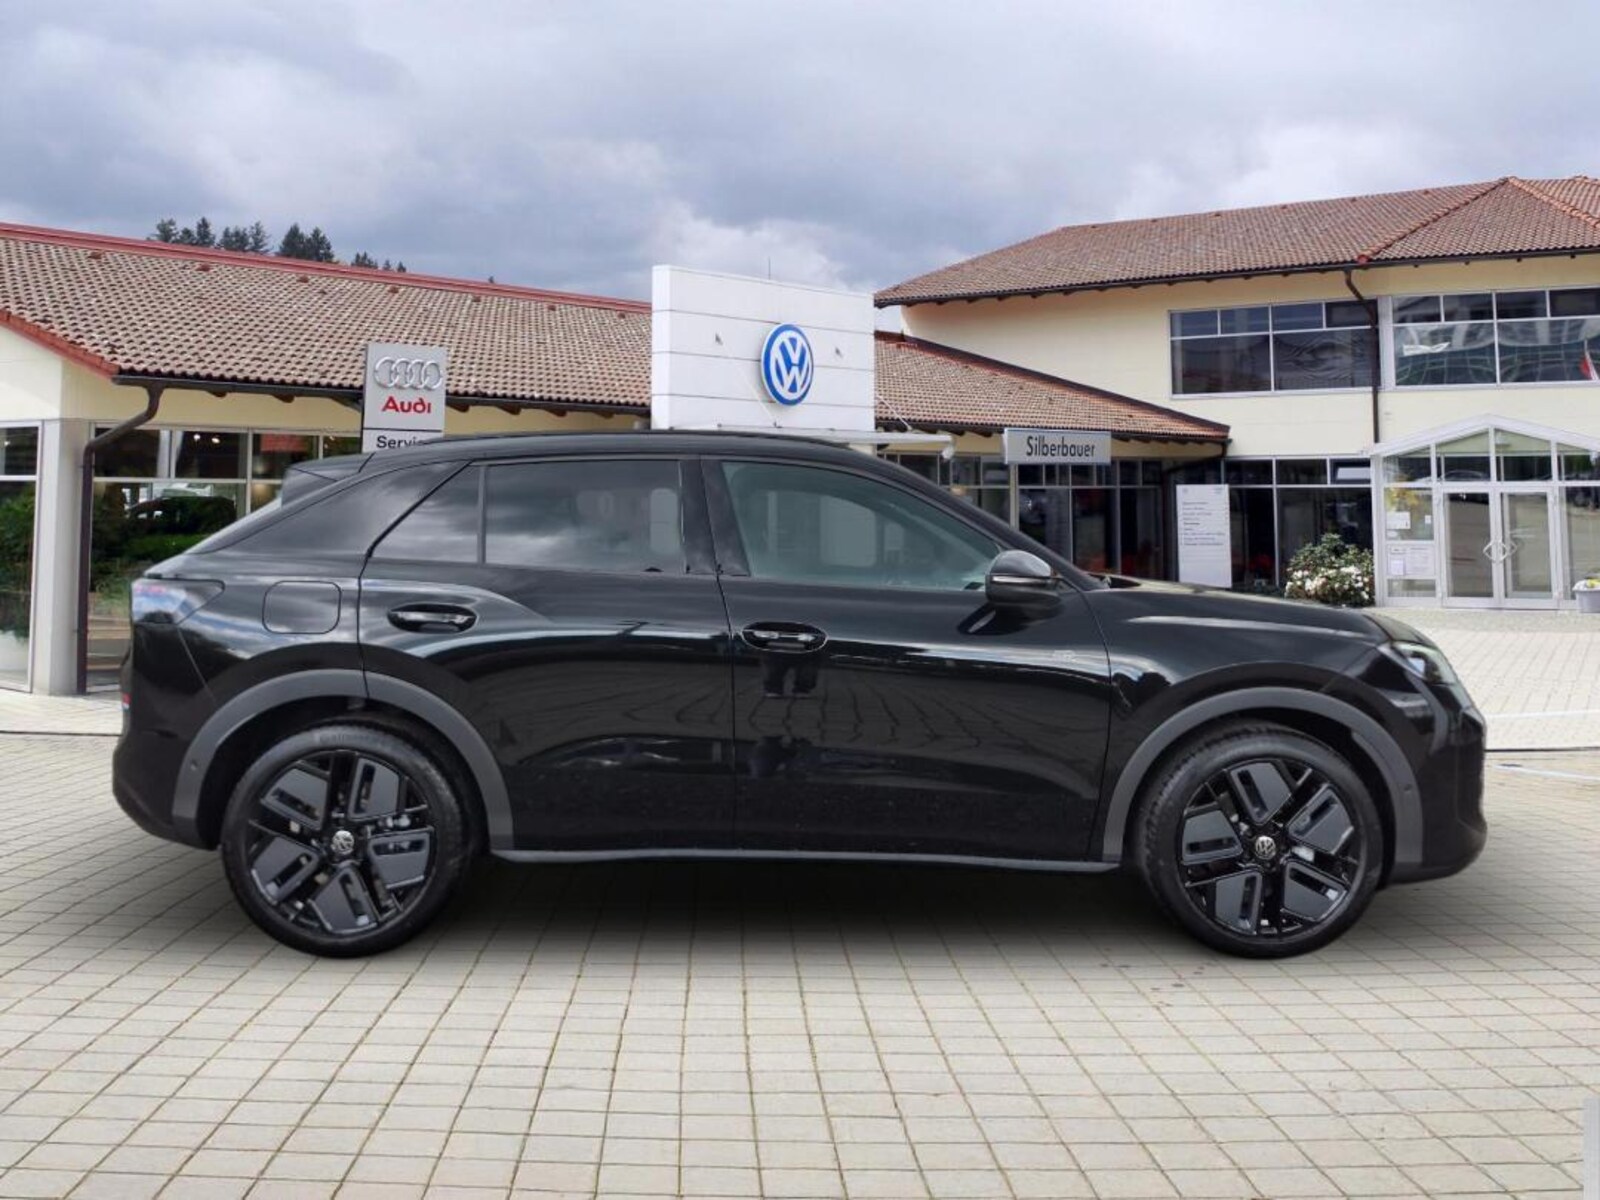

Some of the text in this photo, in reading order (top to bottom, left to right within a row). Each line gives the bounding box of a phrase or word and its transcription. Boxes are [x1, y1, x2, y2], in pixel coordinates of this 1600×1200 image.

[381, 396, 432, 414] Audi
[376, 435, 424, 449] Servi
[1026, 435, 1096, 457] Silberbauer
